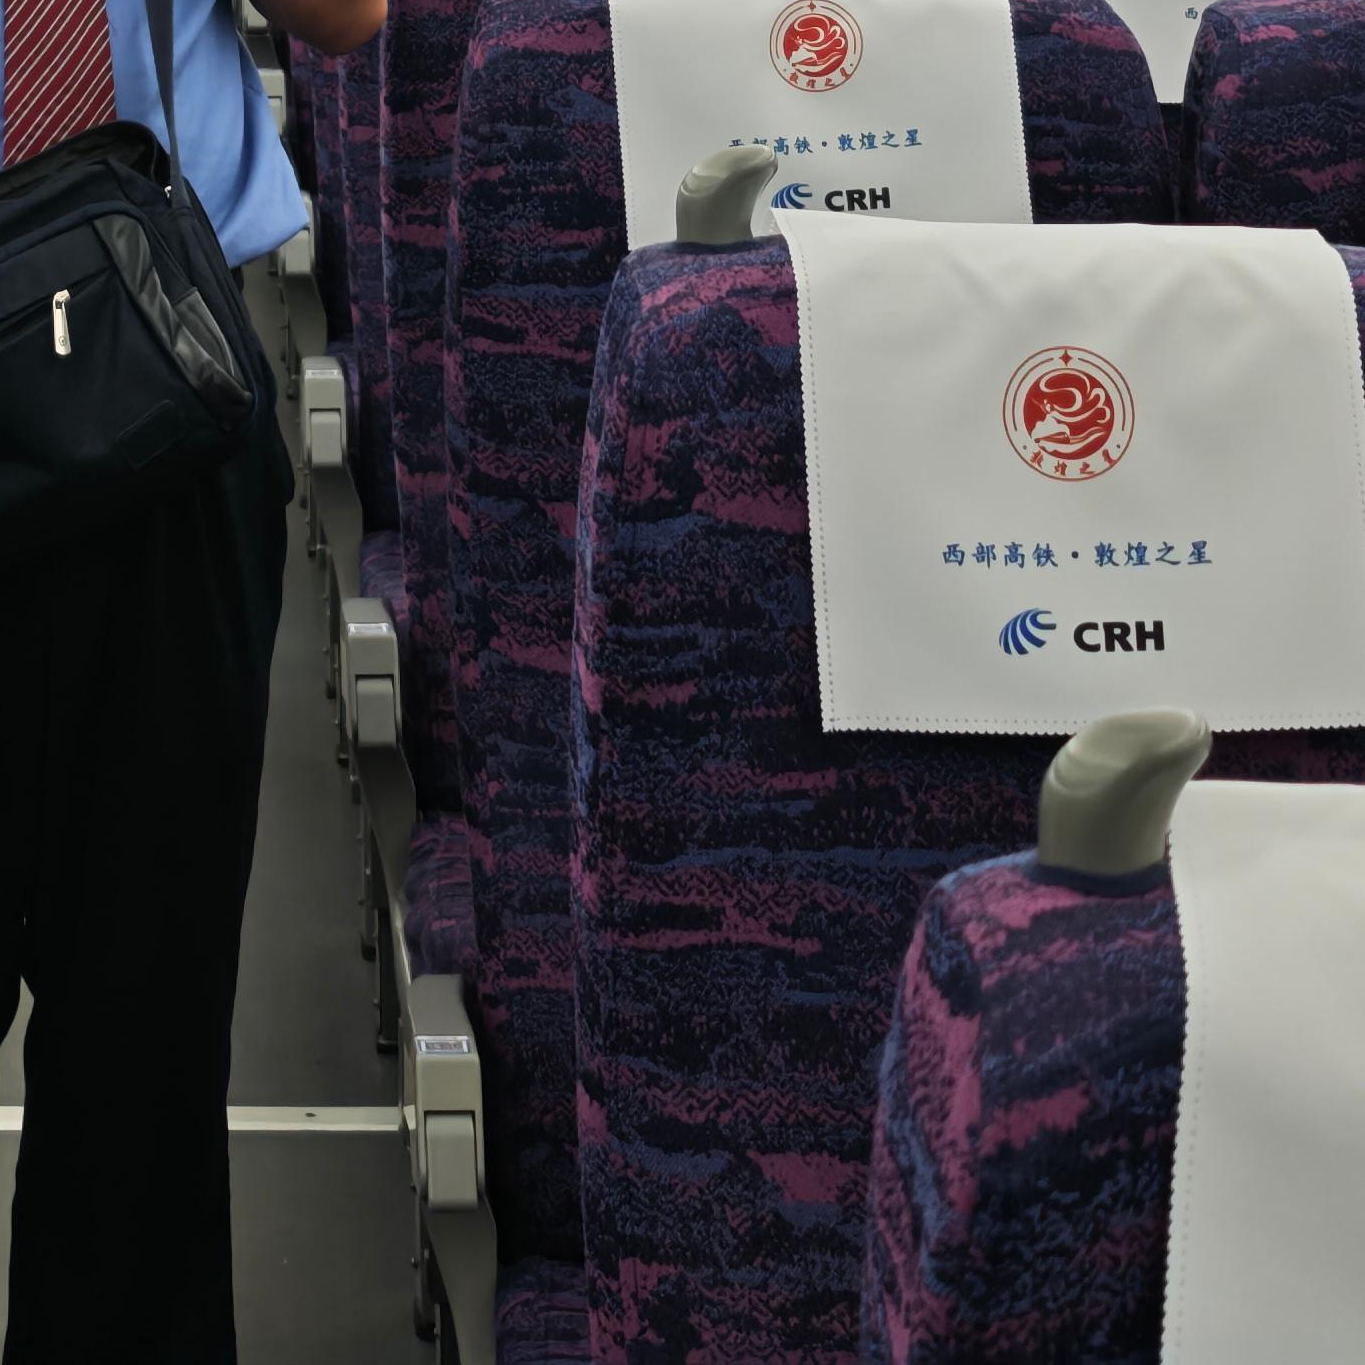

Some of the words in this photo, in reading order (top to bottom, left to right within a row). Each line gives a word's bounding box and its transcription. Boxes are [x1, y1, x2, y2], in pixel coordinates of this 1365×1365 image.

[824, 187, 891, 212] CRH
[942, 540, 1213, 568] 西部高铁·敦煌之星
[1073, 620, 1166, 652] CRH
